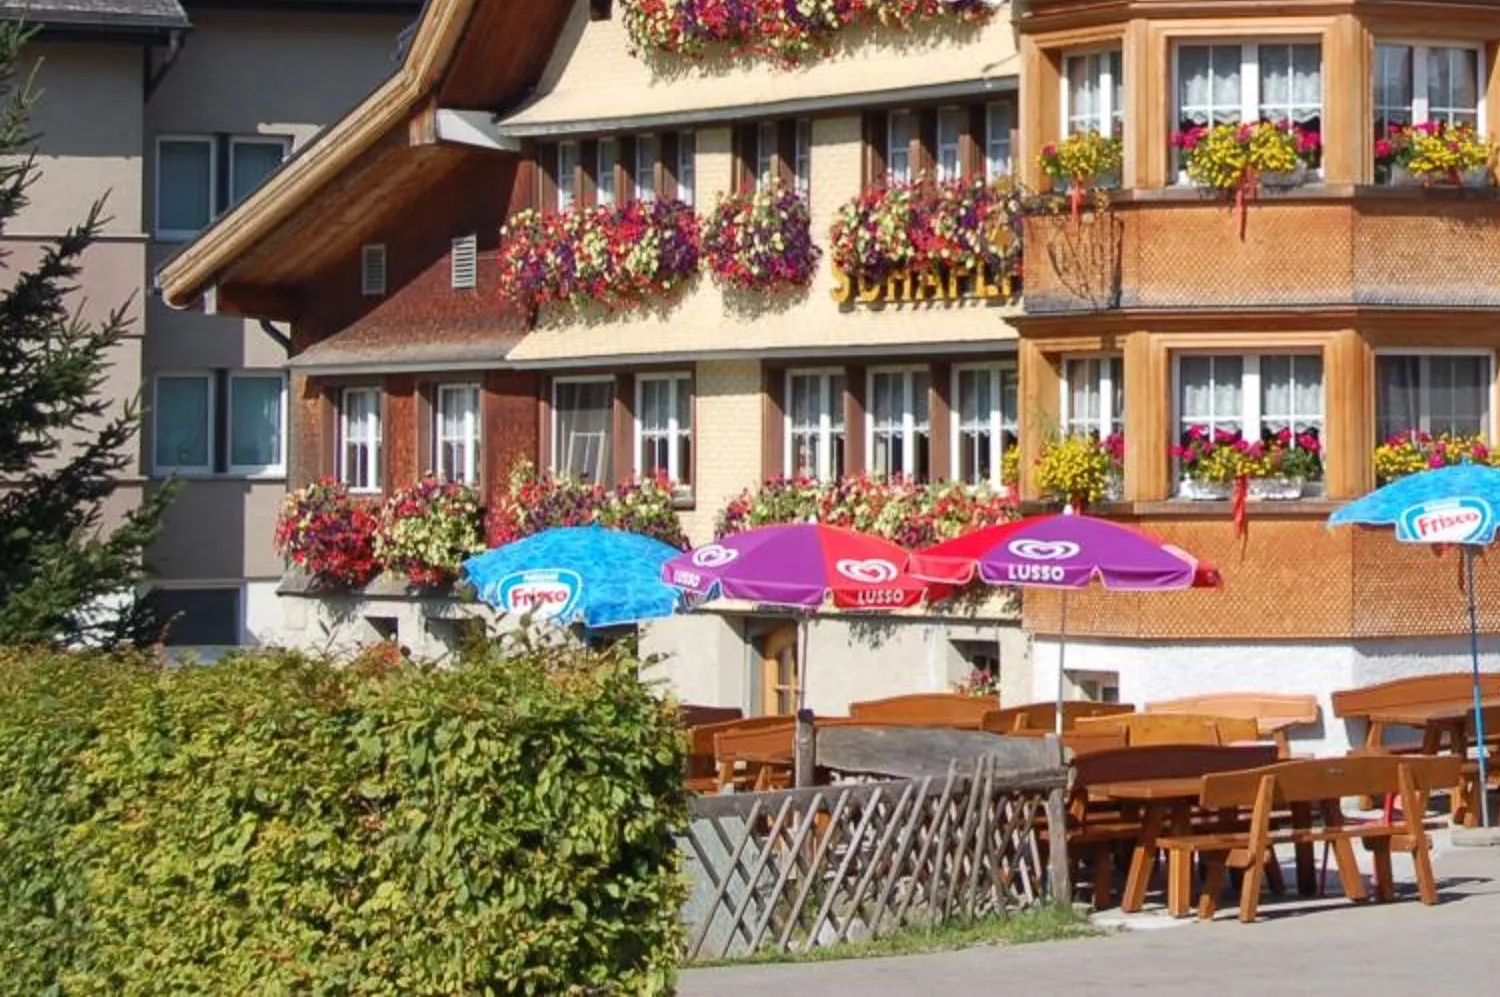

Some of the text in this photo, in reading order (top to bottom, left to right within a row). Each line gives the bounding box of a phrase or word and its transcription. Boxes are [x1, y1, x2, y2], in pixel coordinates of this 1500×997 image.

[1418, 511, 1480, 537] Frisco
[1008, 564, 1065, 581] LUSSO
[858, 588, 905, 604] LUSSO
